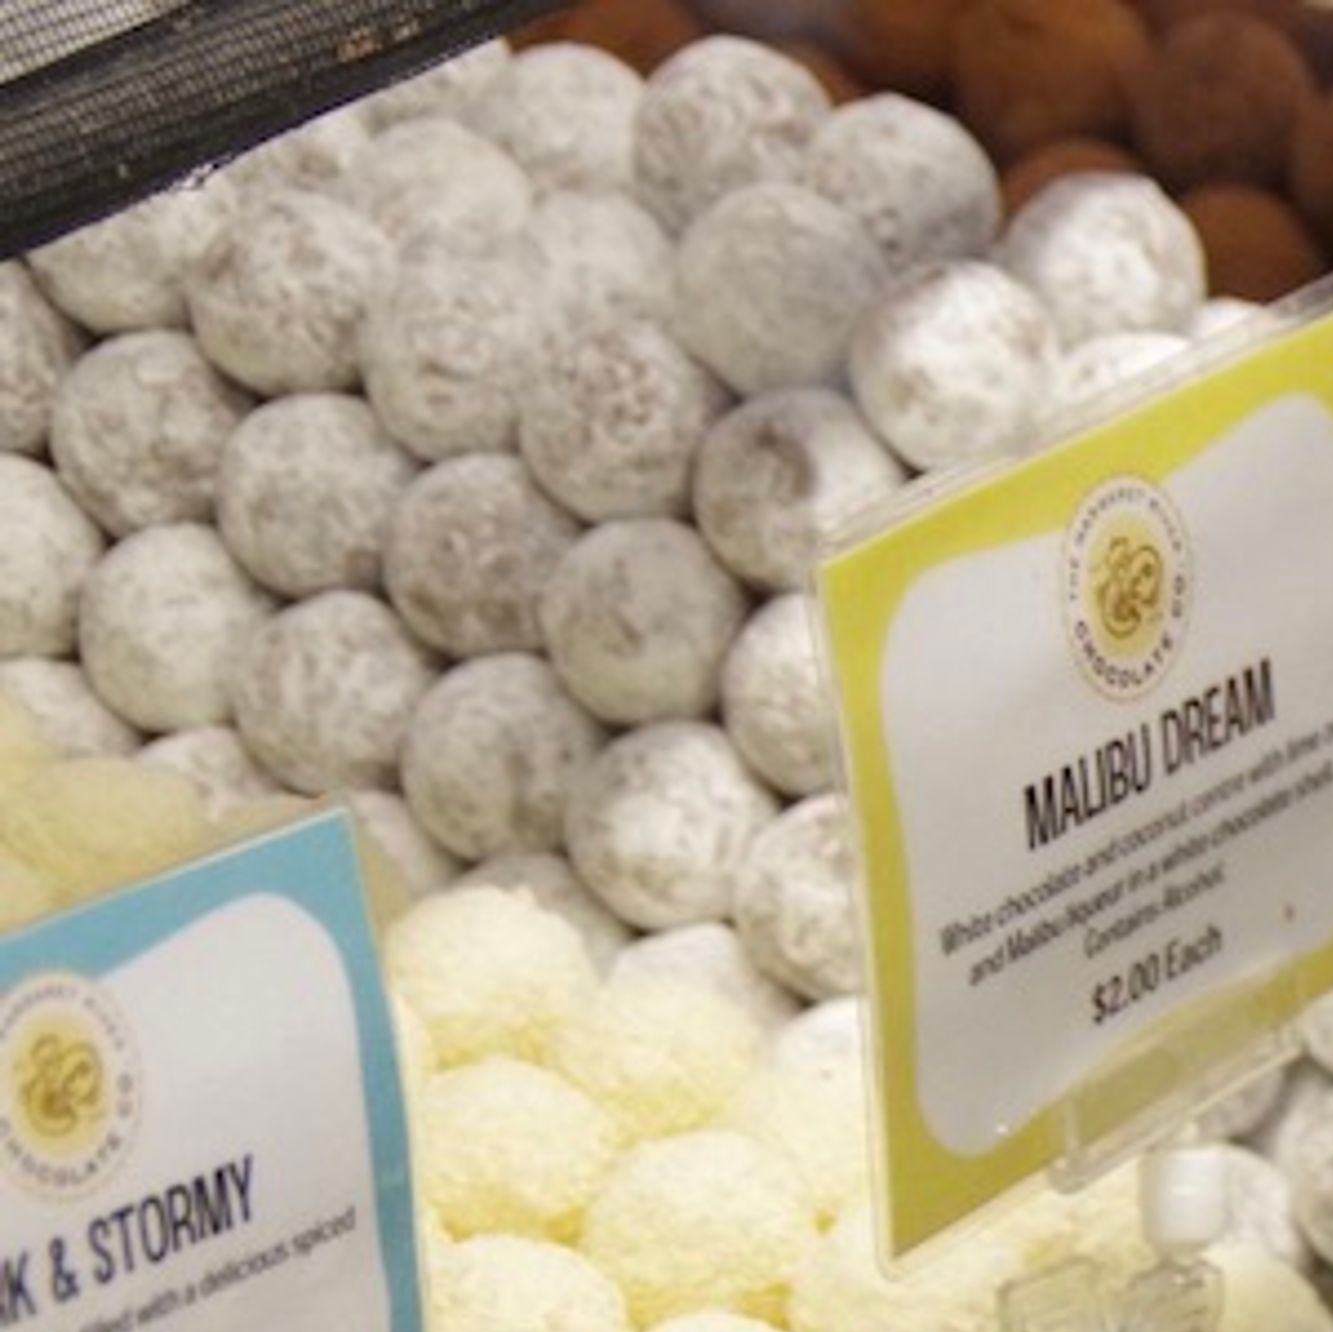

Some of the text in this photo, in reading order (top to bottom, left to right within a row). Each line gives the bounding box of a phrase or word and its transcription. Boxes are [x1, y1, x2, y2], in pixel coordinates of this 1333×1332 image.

[1073, 620, 1173, 691] CHOCOLATE
[1025, 657, 1275, 850] MALIBU DREAM
[995, 863, 1083, 926] chocolate
[1084, 839, 1119, 877] and
[1006, 921, 1061, 963] Malibu
[1211, 788, 1294, 849] chocolate
[1083, 903, 1161, 960] Contains
[1092, 922, 1222, 1025] $2.00 Each
[48, 1236, 81, 1303] &
[88, 1152, 254, 1285] STORMY
[137, 1289, 180, 1326] with
[199, 1243, 290, 1297] delicious
[291, 1204, 356, 1261] spiced
